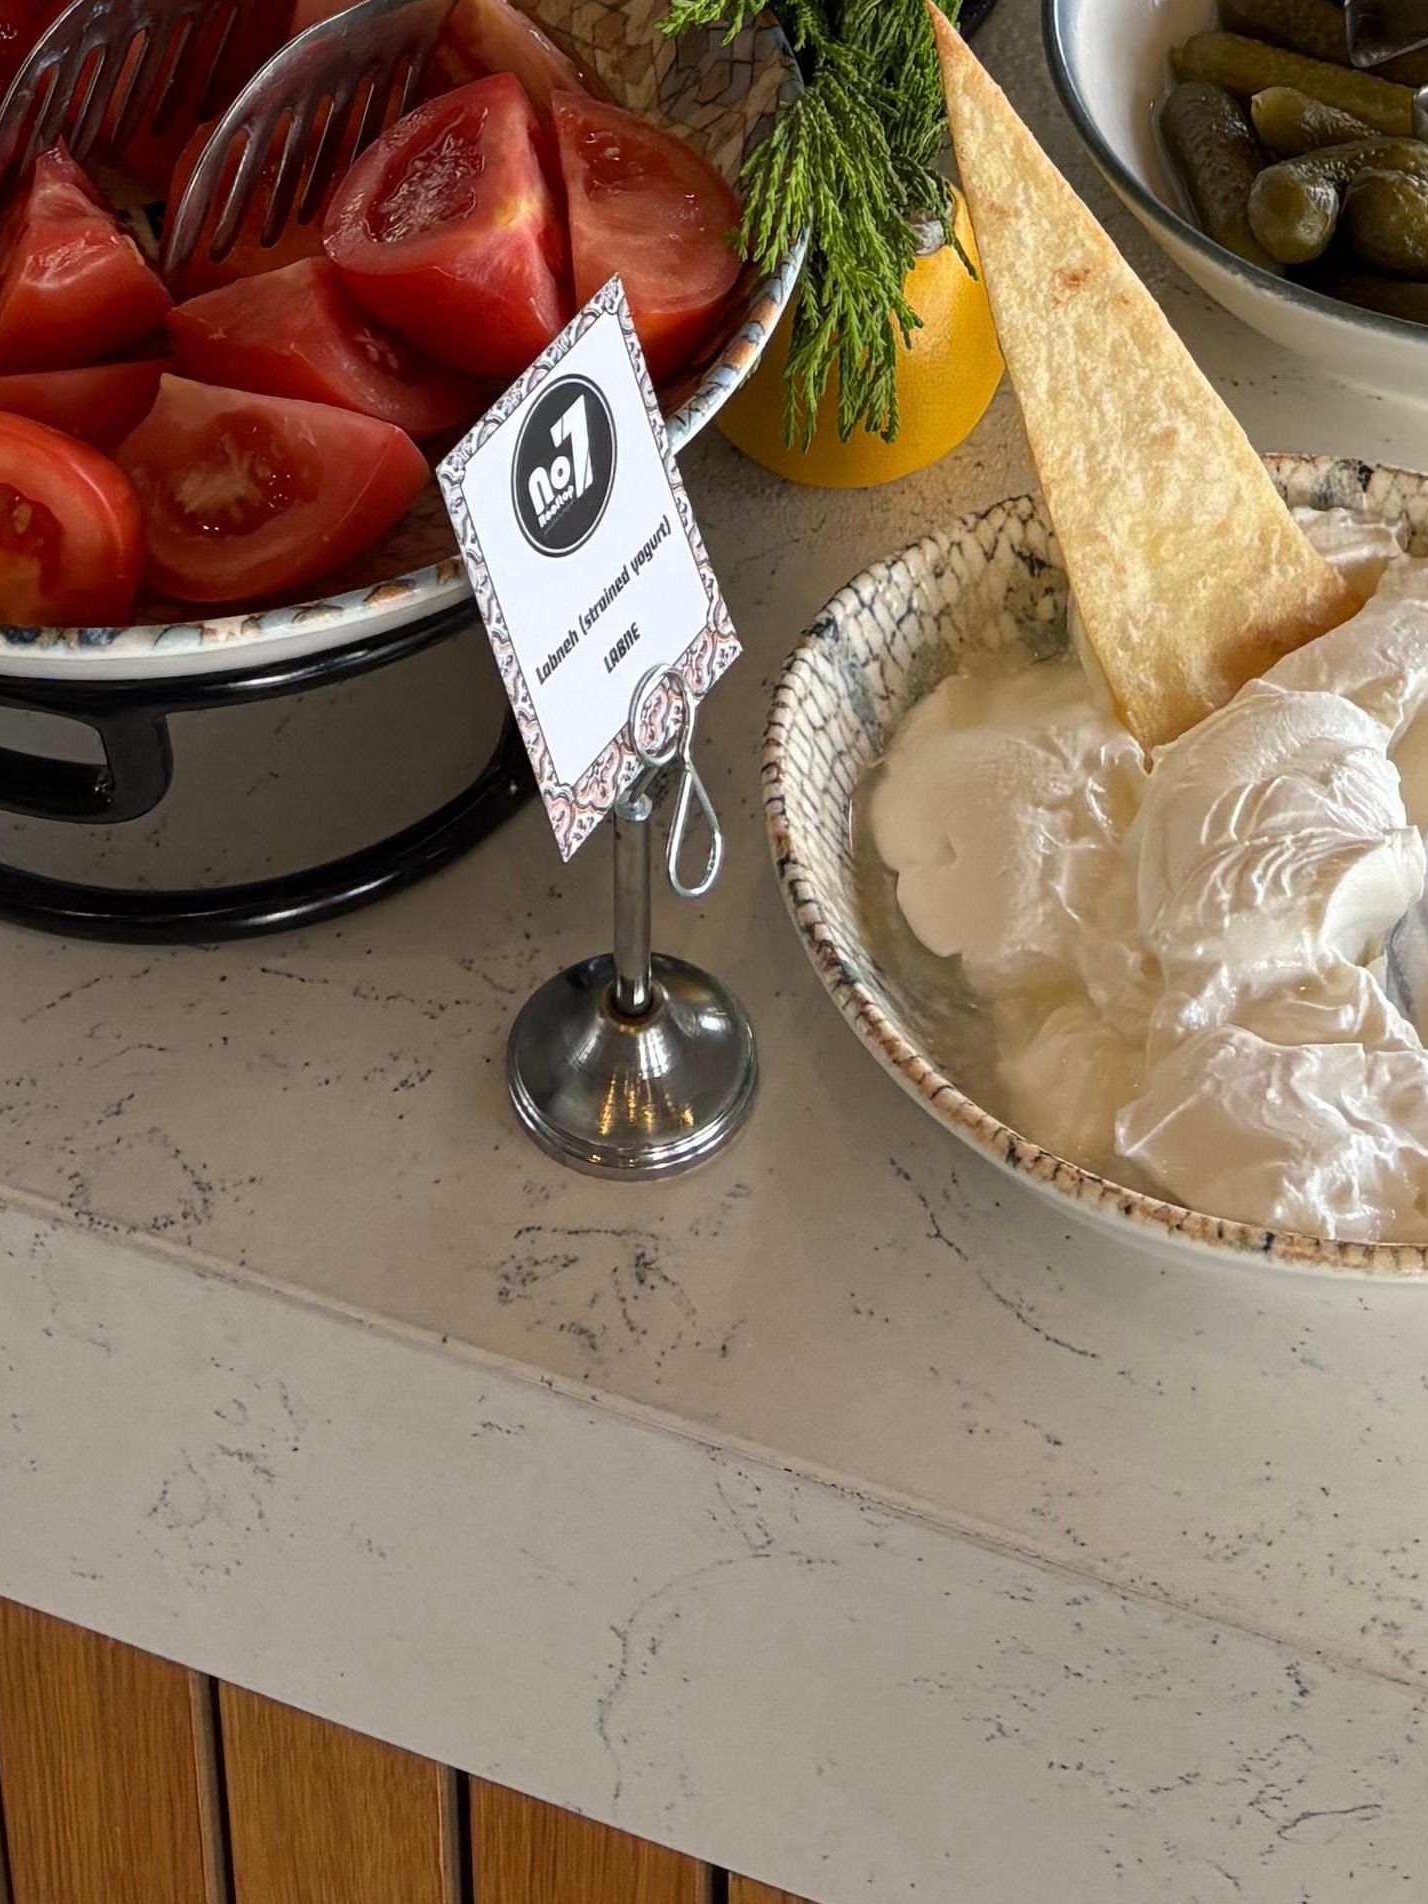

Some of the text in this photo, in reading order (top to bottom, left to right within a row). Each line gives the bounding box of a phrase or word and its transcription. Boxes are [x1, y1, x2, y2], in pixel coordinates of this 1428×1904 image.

[536, 514, 671, 685] Labneh (strained yogurt)
[604, 622, 641, 674] LABNE
